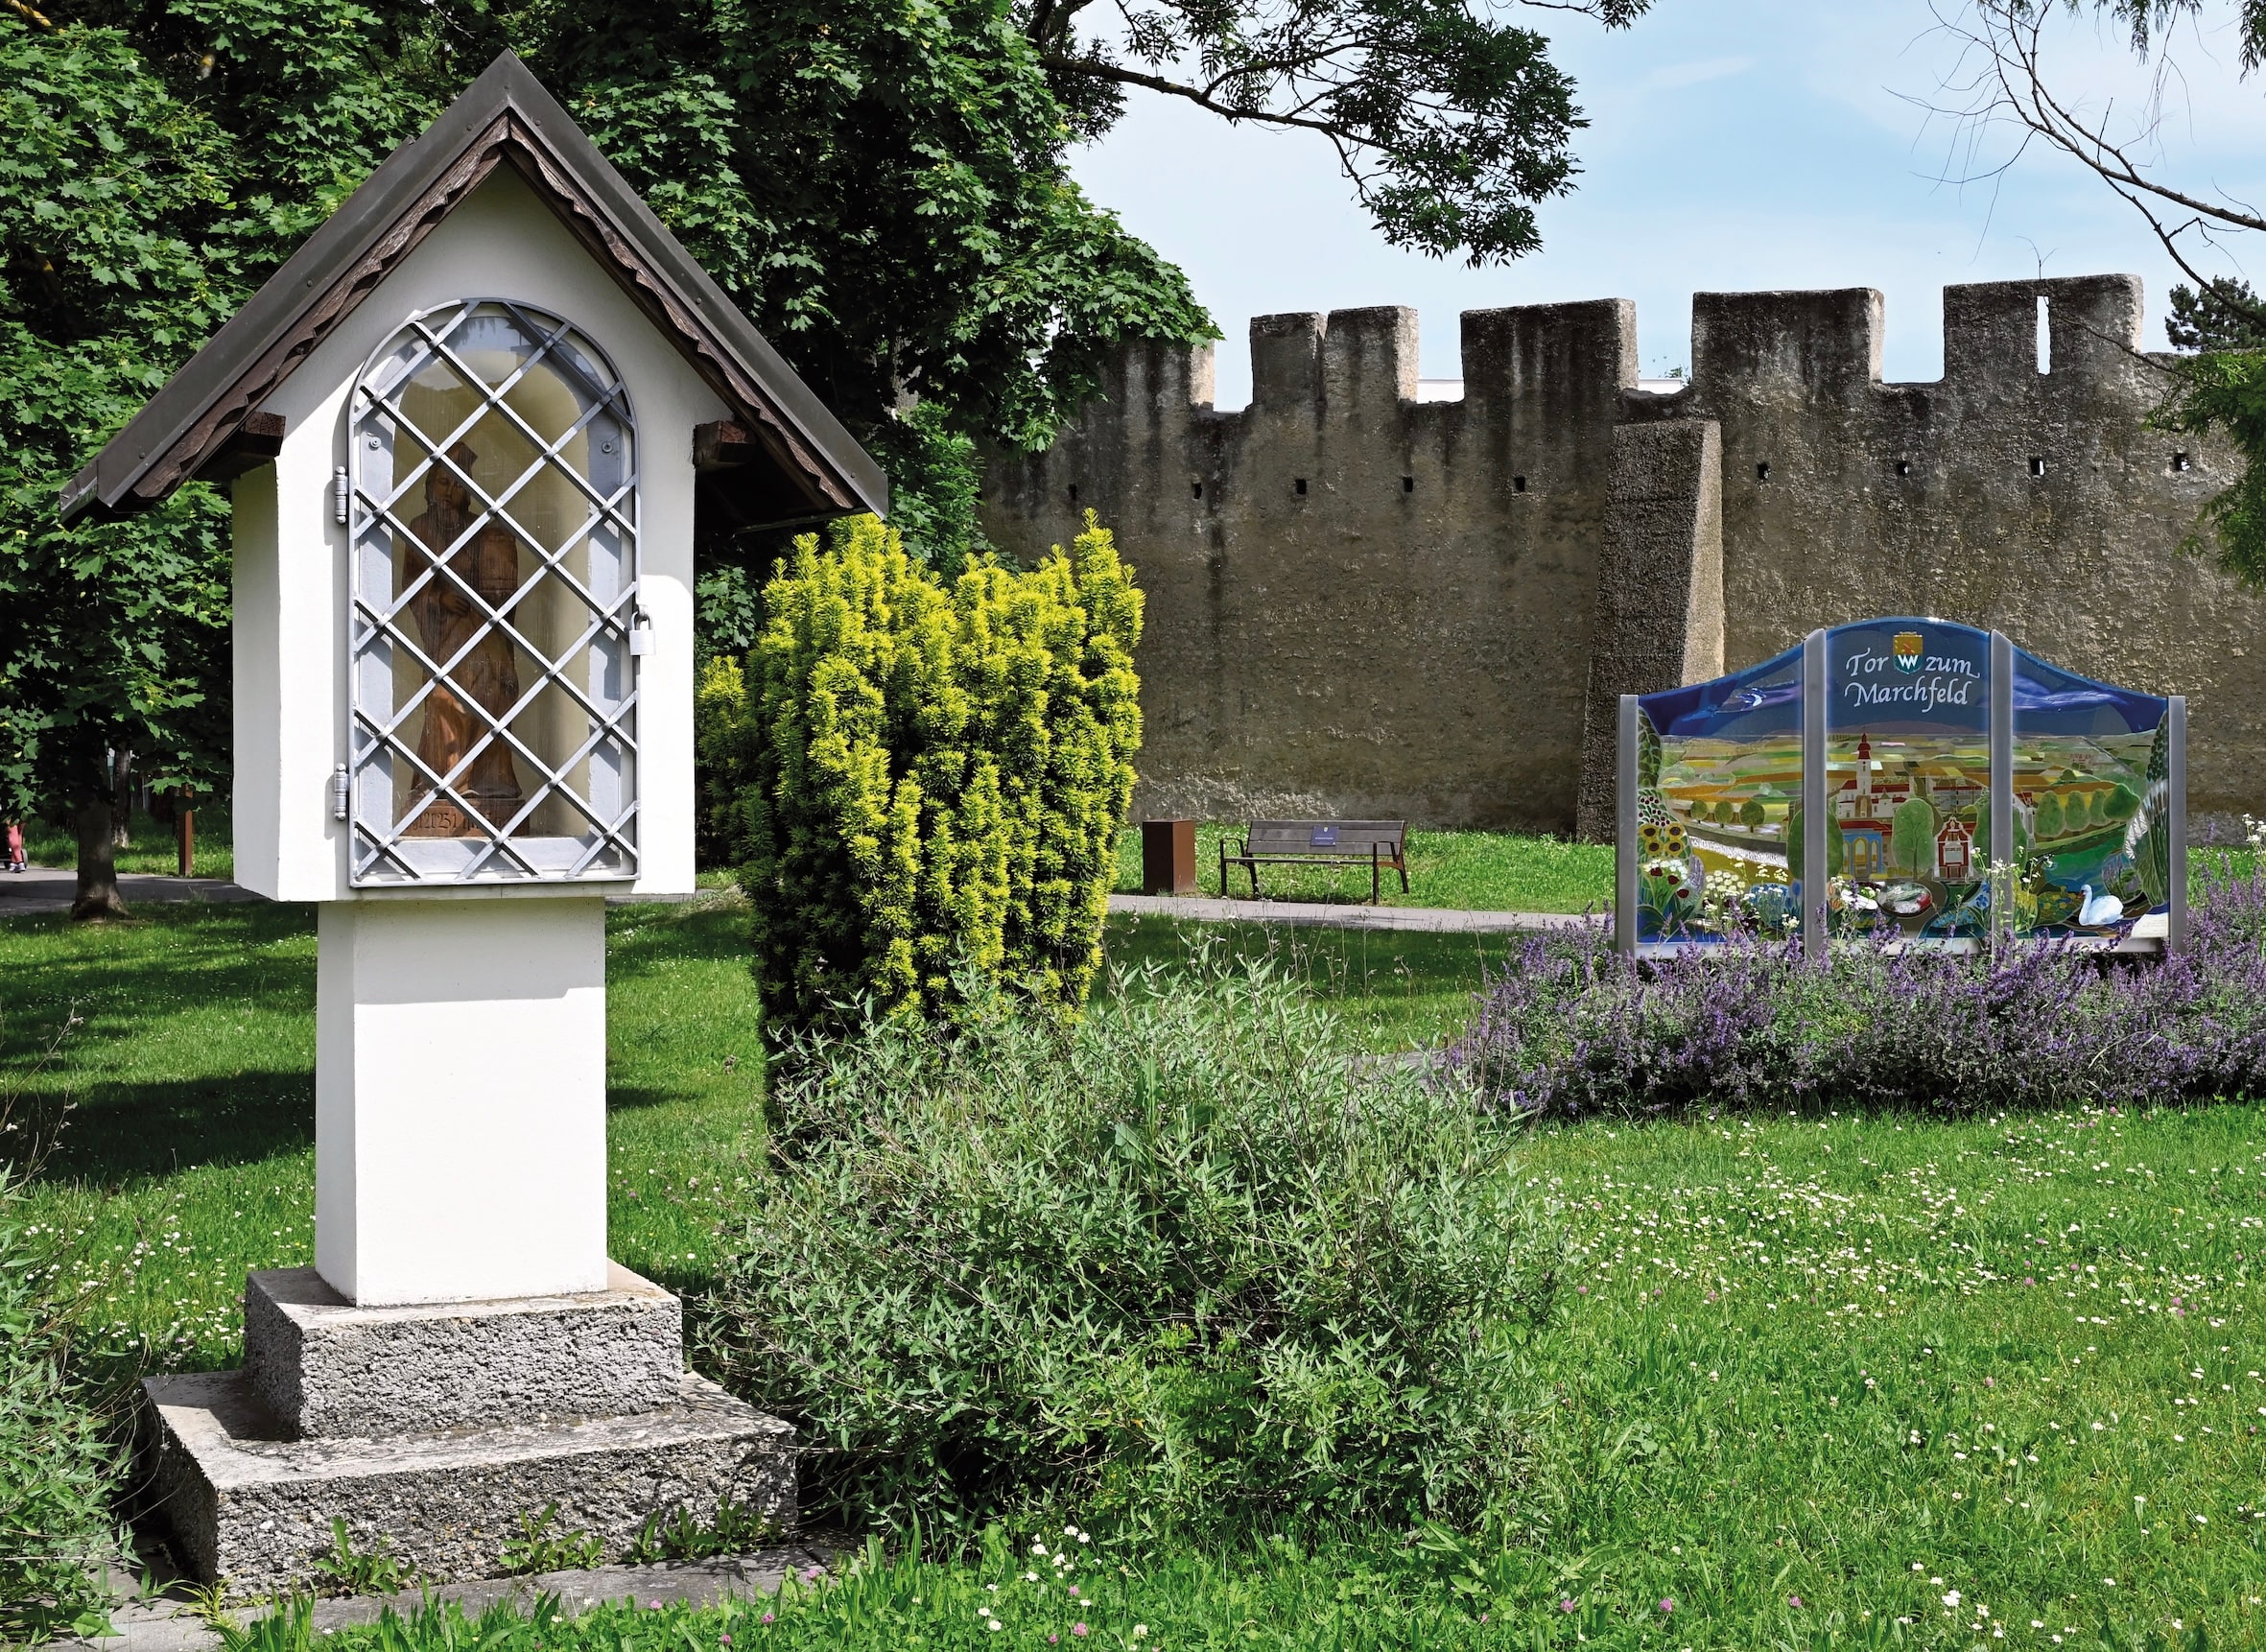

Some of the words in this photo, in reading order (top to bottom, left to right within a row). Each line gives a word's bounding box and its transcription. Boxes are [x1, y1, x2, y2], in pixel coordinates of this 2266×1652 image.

[1846, 648, 1889, 676] Tor
[1925, 655, 1981, 678] zum
[1844, 675, 1972, 713] Marchfeld
